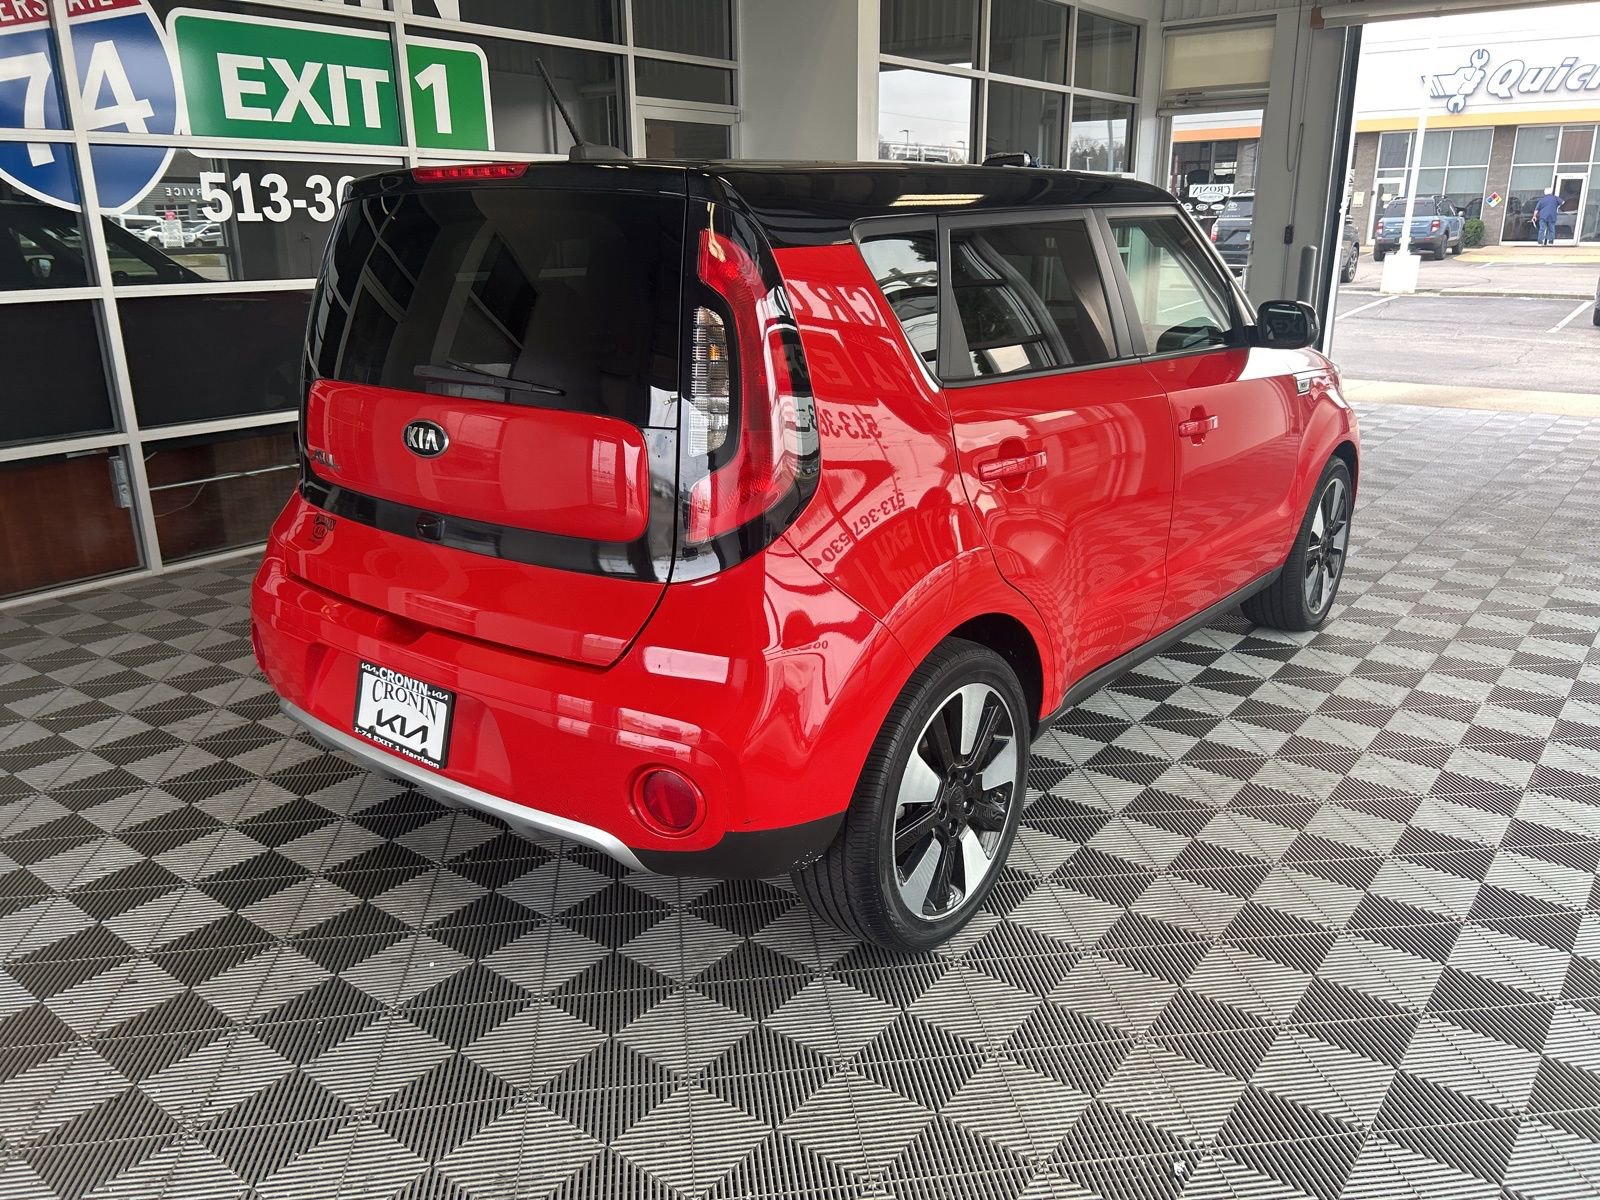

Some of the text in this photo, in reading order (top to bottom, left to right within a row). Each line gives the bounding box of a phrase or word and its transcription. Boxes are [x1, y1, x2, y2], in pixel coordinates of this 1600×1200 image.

[217, 53, 452, 134] EXIT 1
[407, 425, 439, 451] KIA
[379, 667, 428, 695] CRONIN
[372, 679, 438, 725] CRONIN
[376, 708, 428, 744] KIA
[355, 727, 371, 739] I-74
[373, 735, 394, 748] EXIT
[402, 748, 440, 769] Harrison
